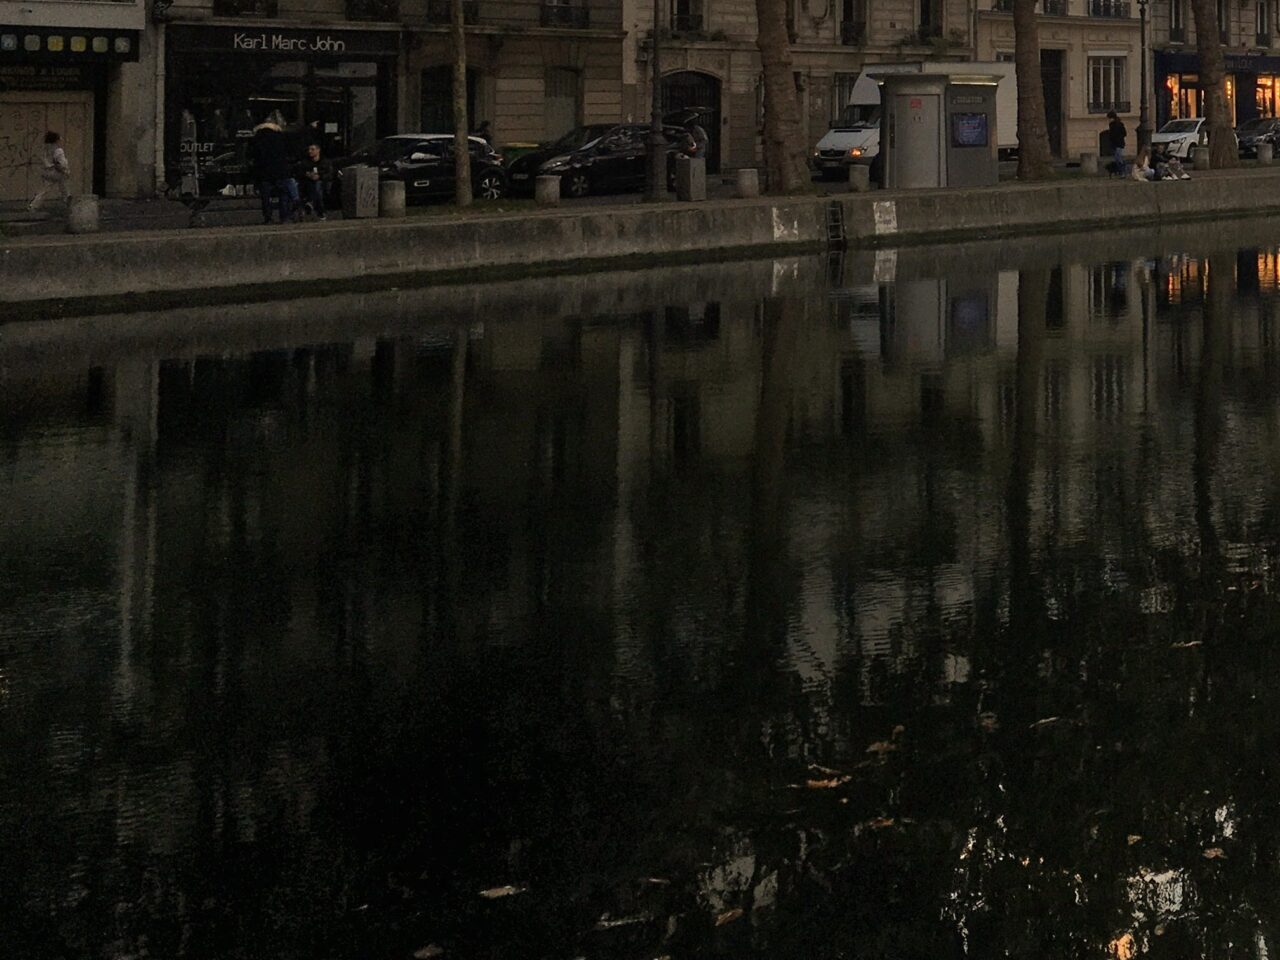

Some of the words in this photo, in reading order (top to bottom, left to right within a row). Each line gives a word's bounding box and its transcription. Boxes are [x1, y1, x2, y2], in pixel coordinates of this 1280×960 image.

[233, 33, 268, 50] Karl
[272, 34, 307, 51] Marc
[309, 36, 346, 52] John
[180, 142, 215, 153] OUTLET
